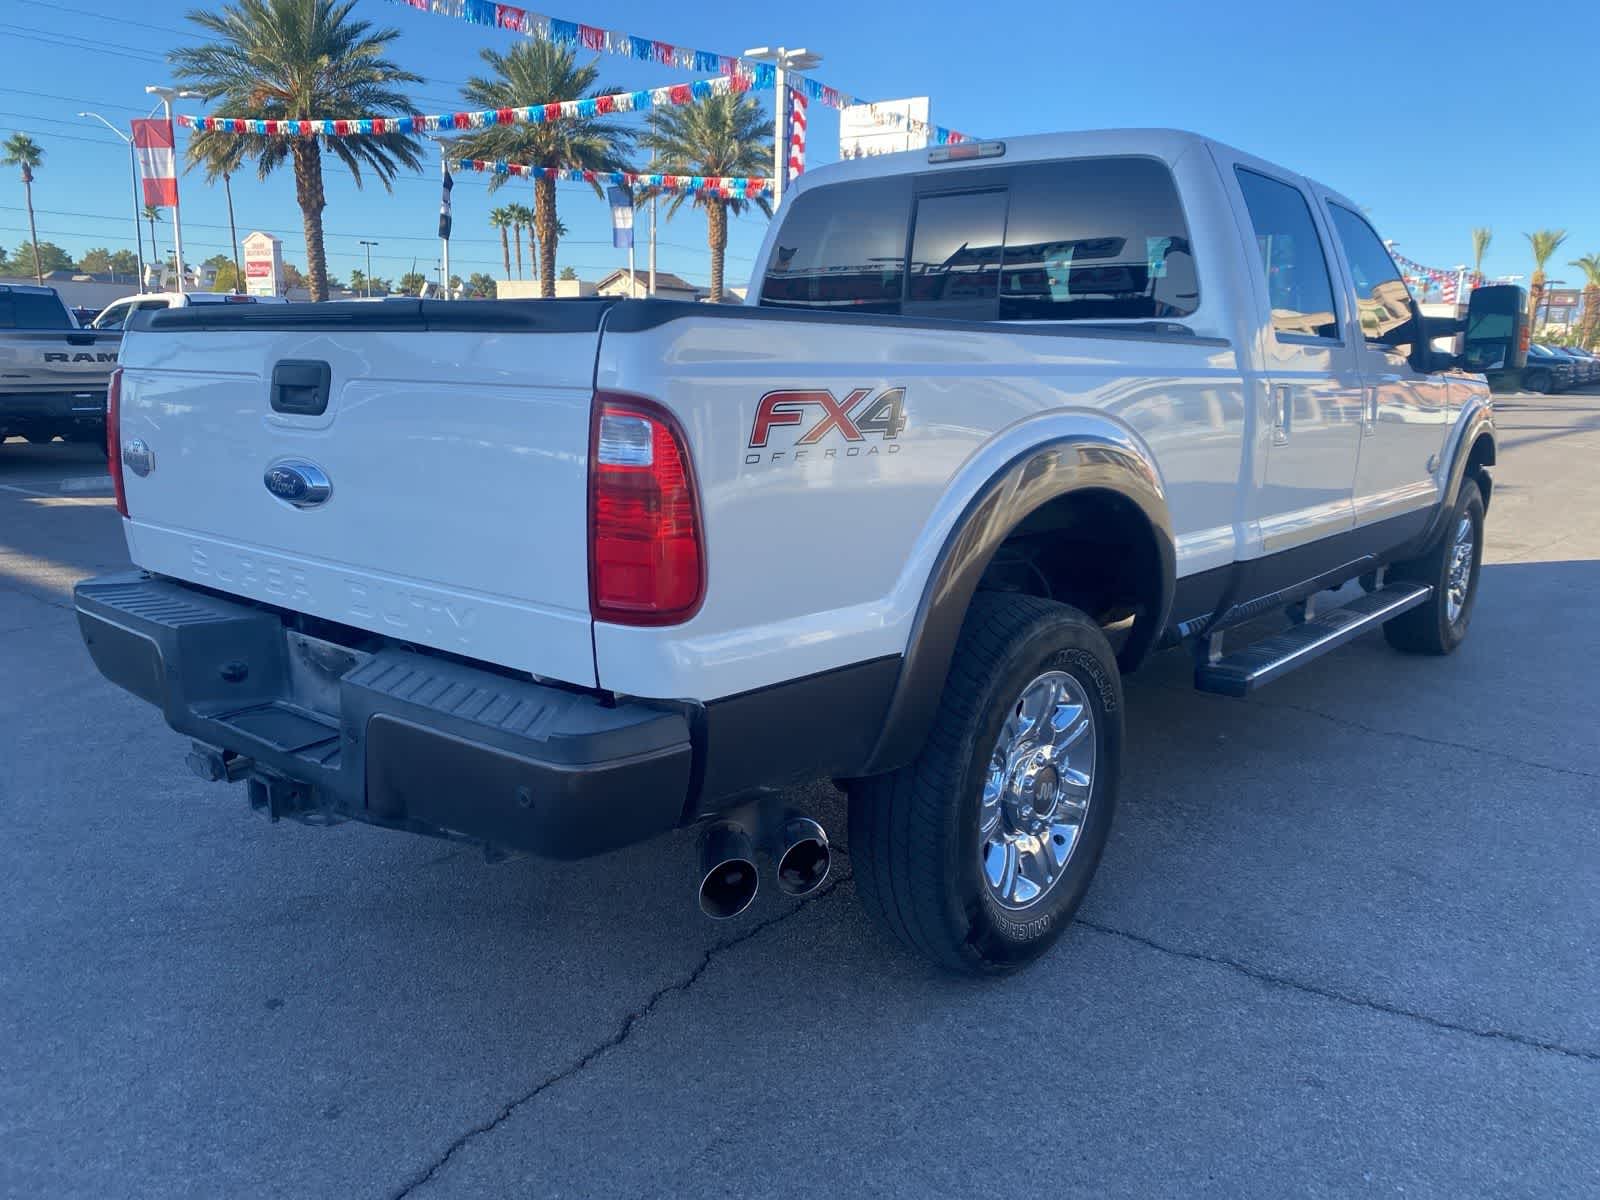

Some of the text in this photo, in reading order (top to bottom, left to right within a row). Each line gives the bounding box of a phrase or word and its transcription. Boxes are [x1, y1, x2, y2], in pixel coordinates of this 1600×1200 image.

[44, 353, 119, 362] RAM
[748, 386, 906, 448] FX4
[745, 444, 901, 465] OFF ROAD
[270, 470, 298, 495] Ford
